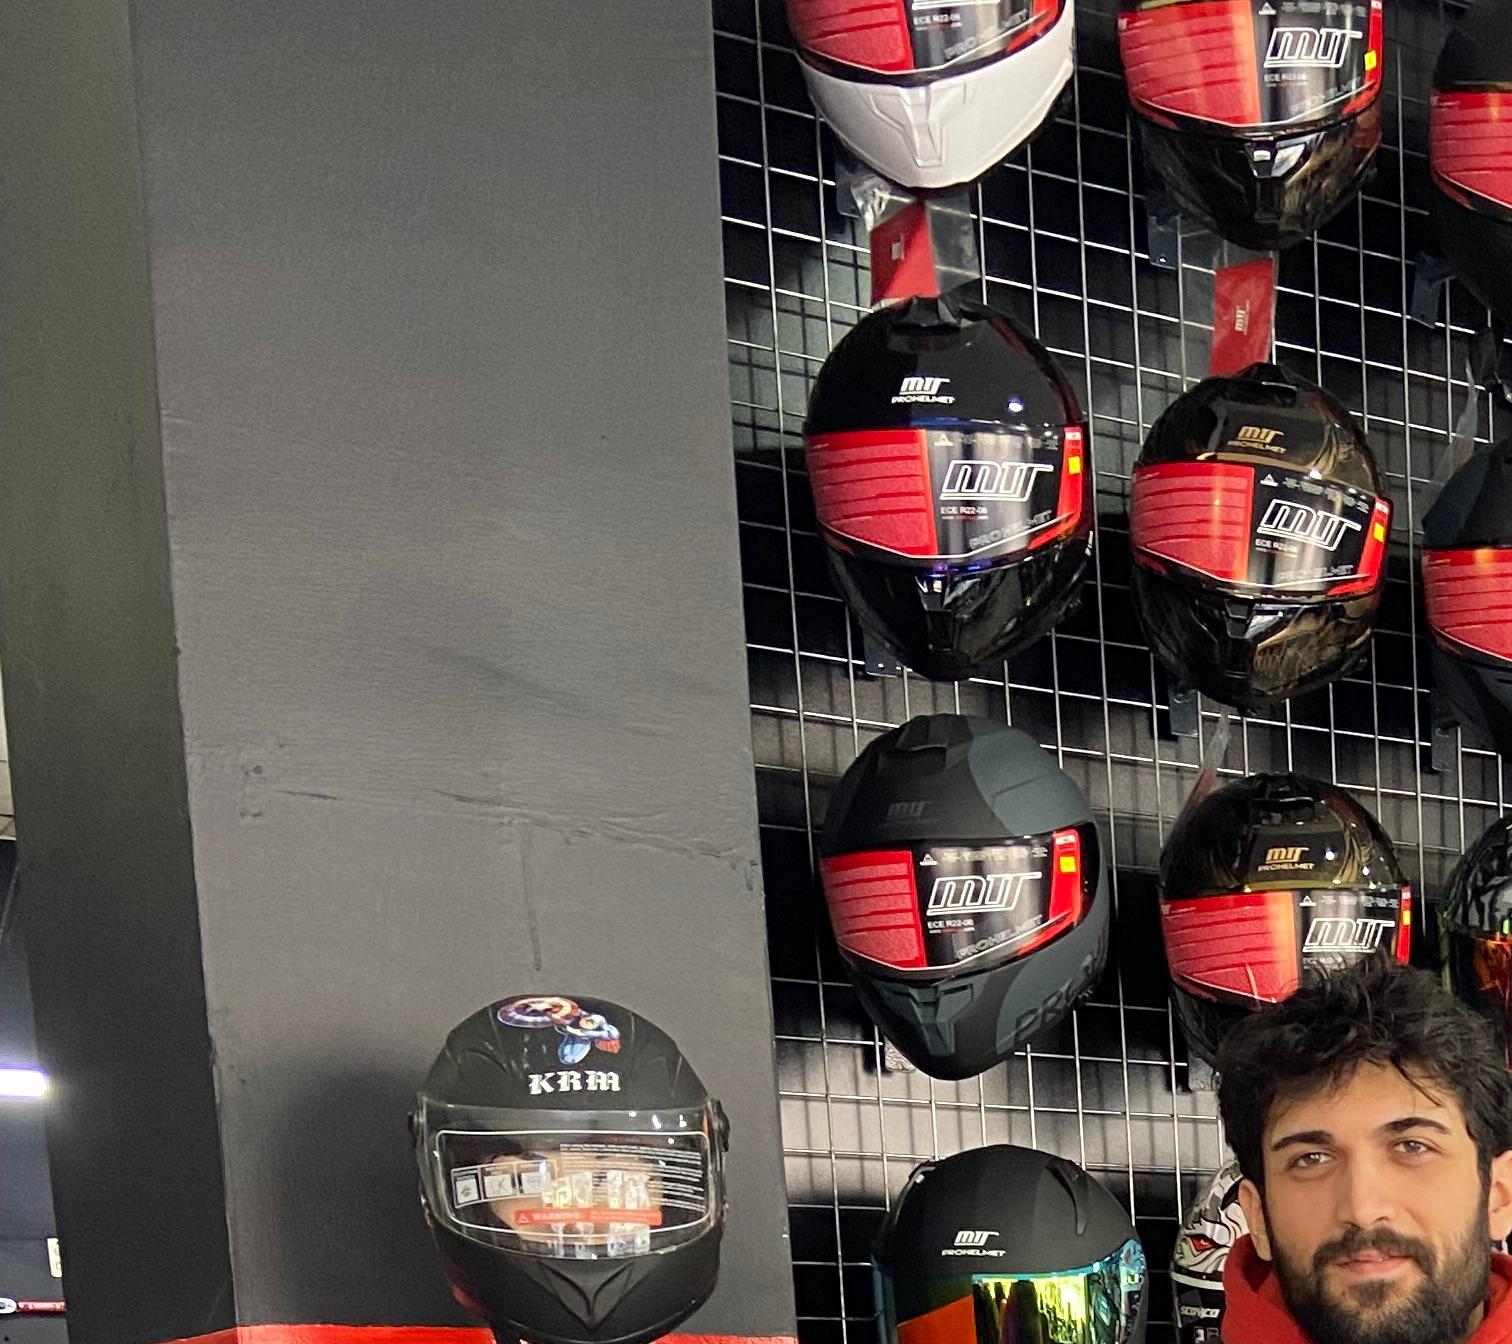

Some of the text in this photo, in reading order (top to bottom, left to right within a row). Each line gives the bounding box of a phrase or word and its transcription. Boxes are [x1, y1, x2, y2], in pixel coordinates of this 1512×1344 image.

[927, 920, 944, 928] ECE
[529, 1070, 620, 1095] KRM
[941, 1249, 1006, 1257] PROHELMET
